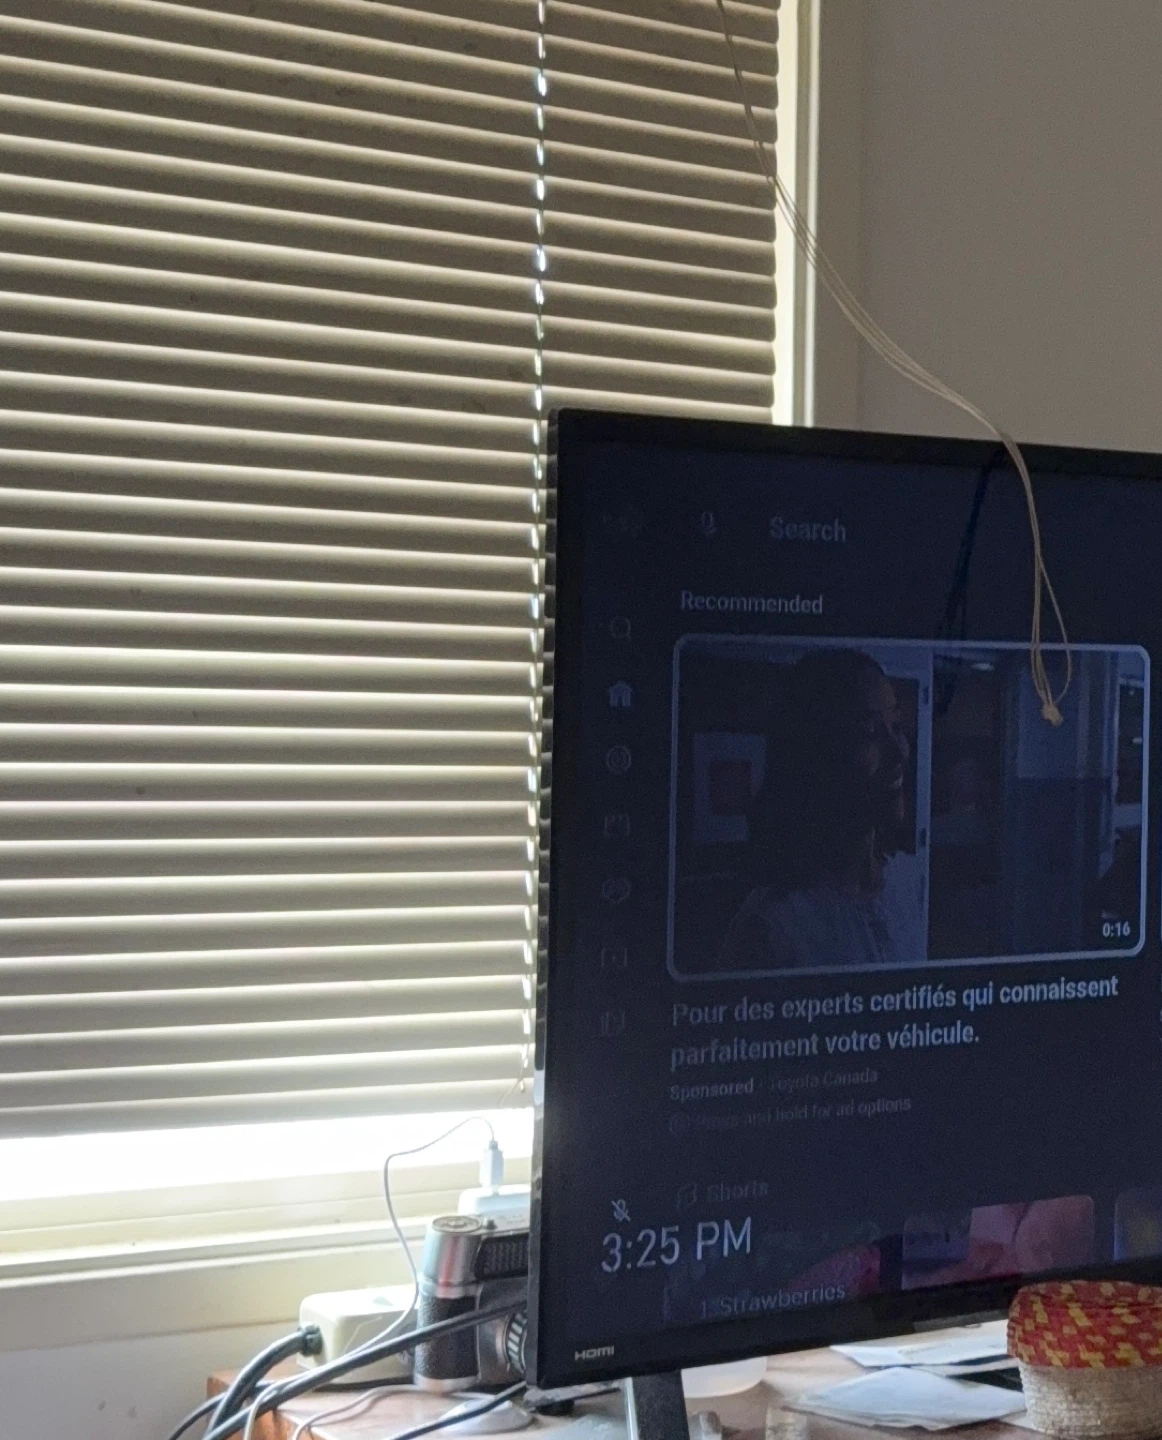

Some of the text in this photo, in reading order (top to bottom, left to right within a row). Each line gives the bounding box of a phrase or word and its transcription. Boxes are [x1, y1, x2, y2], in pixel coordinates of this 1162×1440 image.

[769, 515, 847, 542] Search
[680, 590, 823, 615] Recommended
[1102, 921, 1131, 938] 0:16
[673, 975, 1119, 1027] Pour des experts certifiés qui connaissent
[670, 1019, 980, 1073] parfaitement votre véhicule.
[669, 1077, 754, 1103] Sponsored
[858, 1096, 912, 1118] options
[601, 1216, 752, 1274] 3:25 PM
[720, 1283, 846, 1314] Strawberries
[574, 1345, 615, 1361] HDMI
